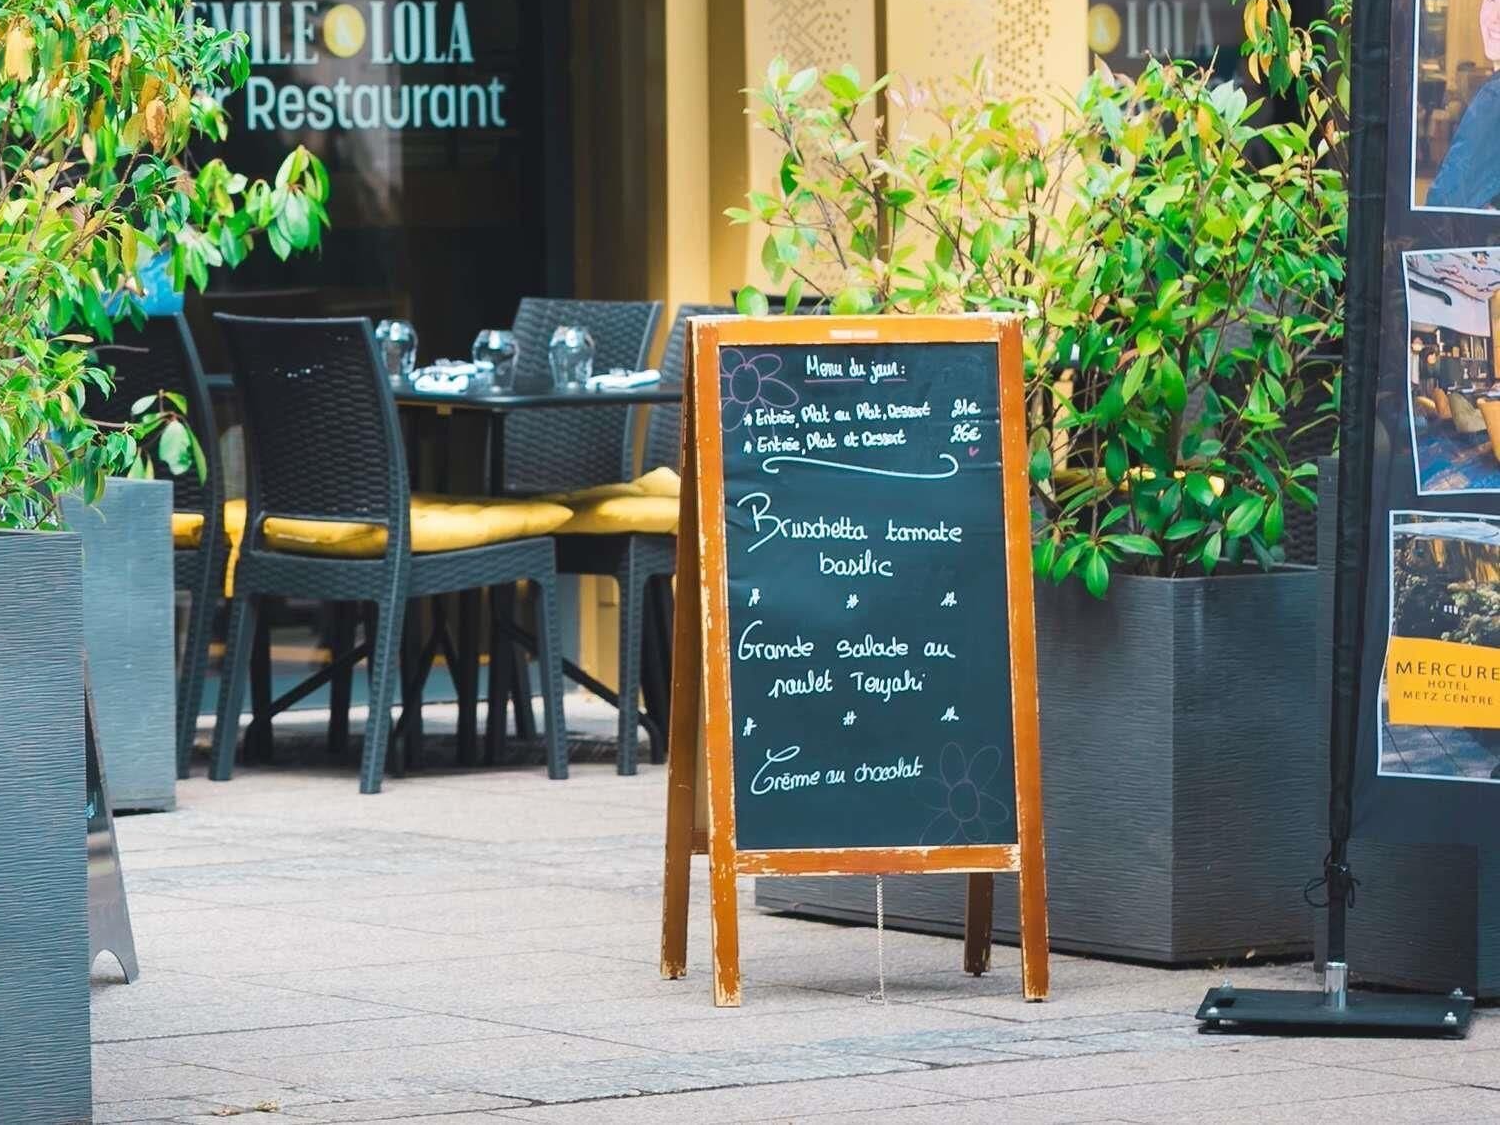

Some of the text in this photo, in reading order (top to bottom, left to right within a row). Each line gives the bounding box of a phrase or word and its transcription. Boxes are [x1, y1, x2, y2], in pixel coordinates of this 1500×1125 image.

[368, 0, 475, 64] LOLA
[1126, 0, 1214, 59] LOLA
[247, 76, 507, 131] Restaurant
[806, 355, 844, 376] Menu
[849, 357, 867, 377] du
[801, 403, 831, 424] Plat
[806, 431, 837, 451] Plat
[844, 431, 859, 447] et
[861, 429, 907, 447] Dessert
[950, 423, 982, 443] 26€
[737, 492, 962, 553] Bruschetta tomate
[819, 549, 893, 576] basilic
[738, 620, 955, 660] Grande salade au
[768, 669, 833, 698] poulet
[1396, 661, 1500, 681] MERCURE
[1403, 690, 1494, 706] METZ CENTRE
[1427, 680, 1470, 691] HOTEL
[825, 769, 846, 784] au
[855, 756, 924, 782] chocolat
